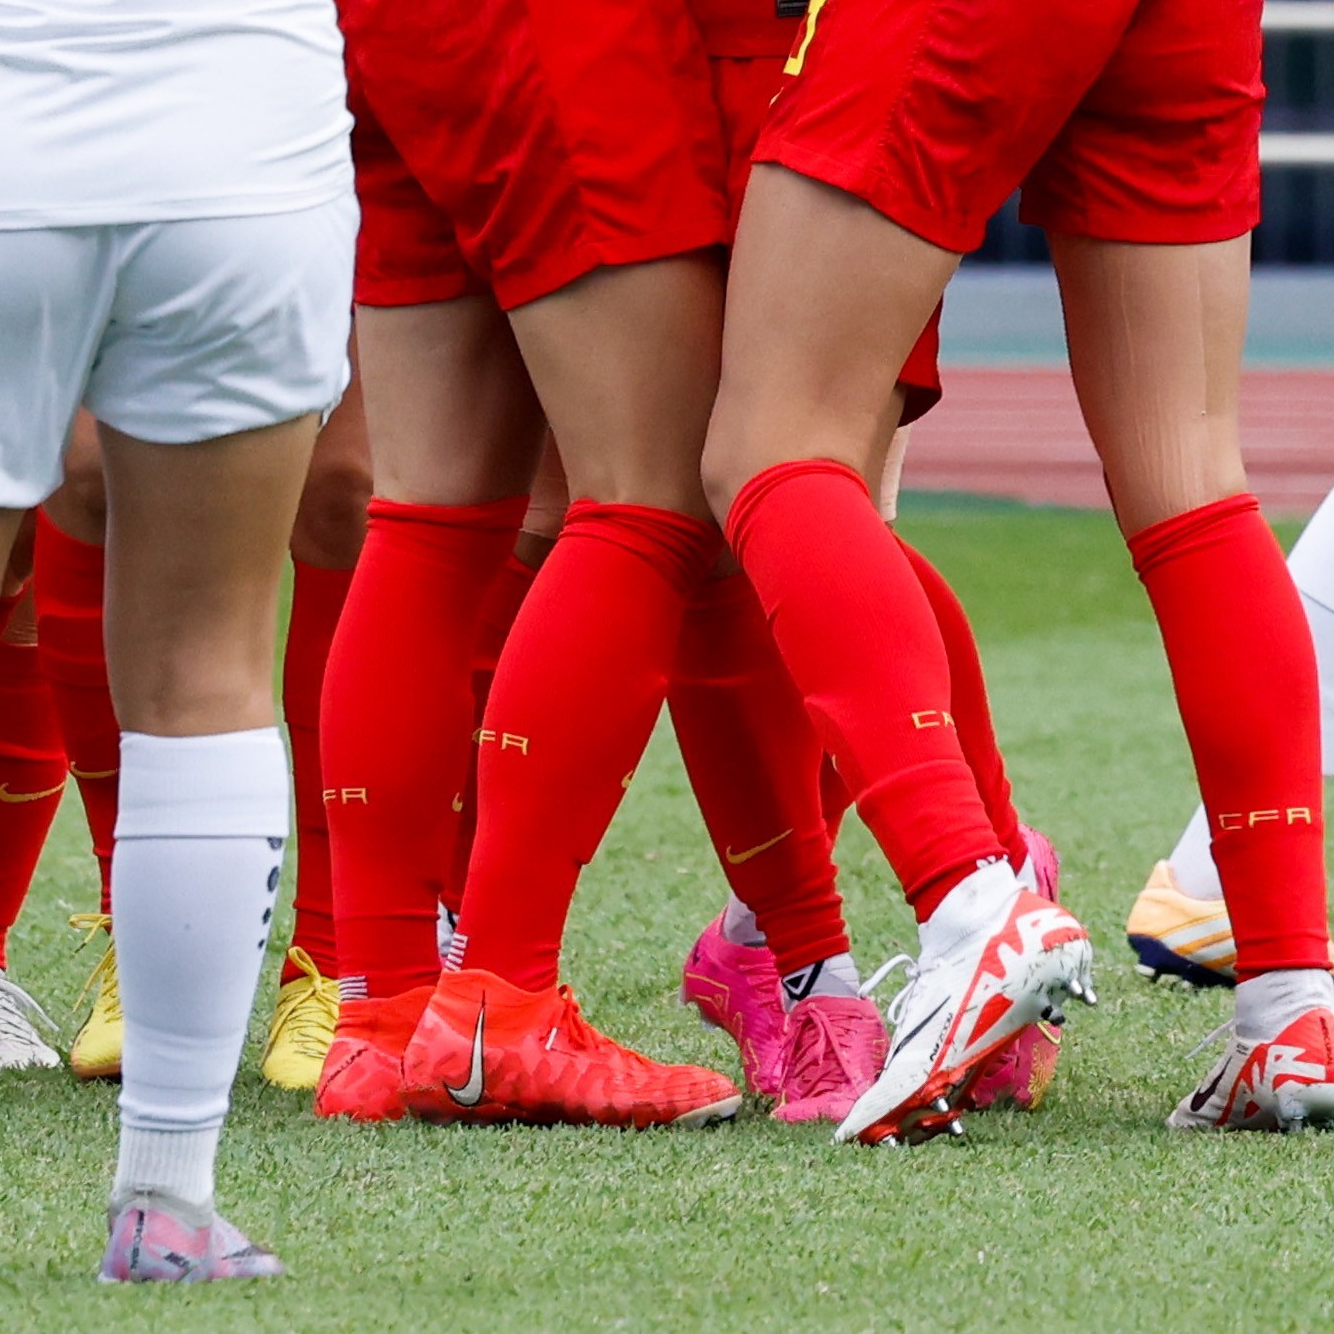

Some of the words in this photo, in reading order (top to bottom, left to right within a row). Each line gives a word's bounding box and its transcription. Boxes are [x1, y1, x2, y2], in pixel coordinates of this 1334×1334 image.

[471, 727, 529, 756] FA
[322, 787, 368, 805] FA
[1218, 807, 1312, 830] CFA
